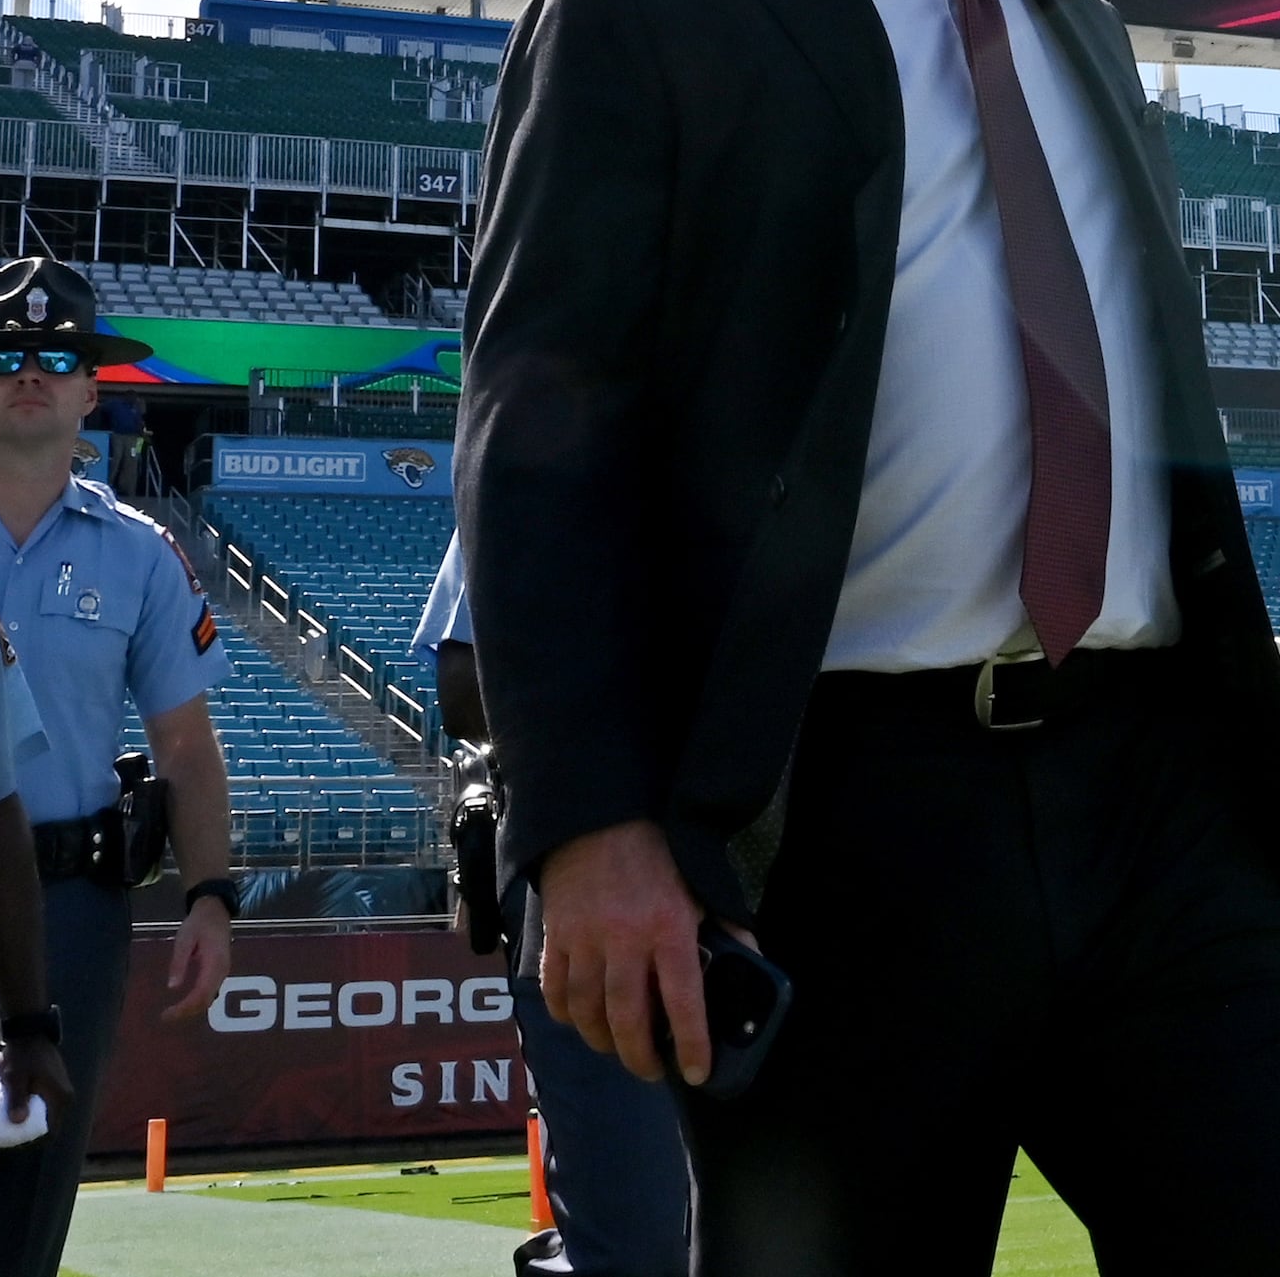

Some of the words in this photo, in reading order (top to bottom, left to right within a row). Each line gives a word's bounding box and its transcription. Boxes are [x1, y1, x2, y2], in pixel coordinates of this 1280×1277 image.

[187, 23, 215, 37] 347
[419, 174, 458, 194] 347
[224, 454, 280, 475] BUD
[284, 456, 360, 477] LIGHT
[1236, 484, 1269, 502] HT
[207, 975, 514, 1033] GEORG
[390, 1059, 536, 1107] SIN
